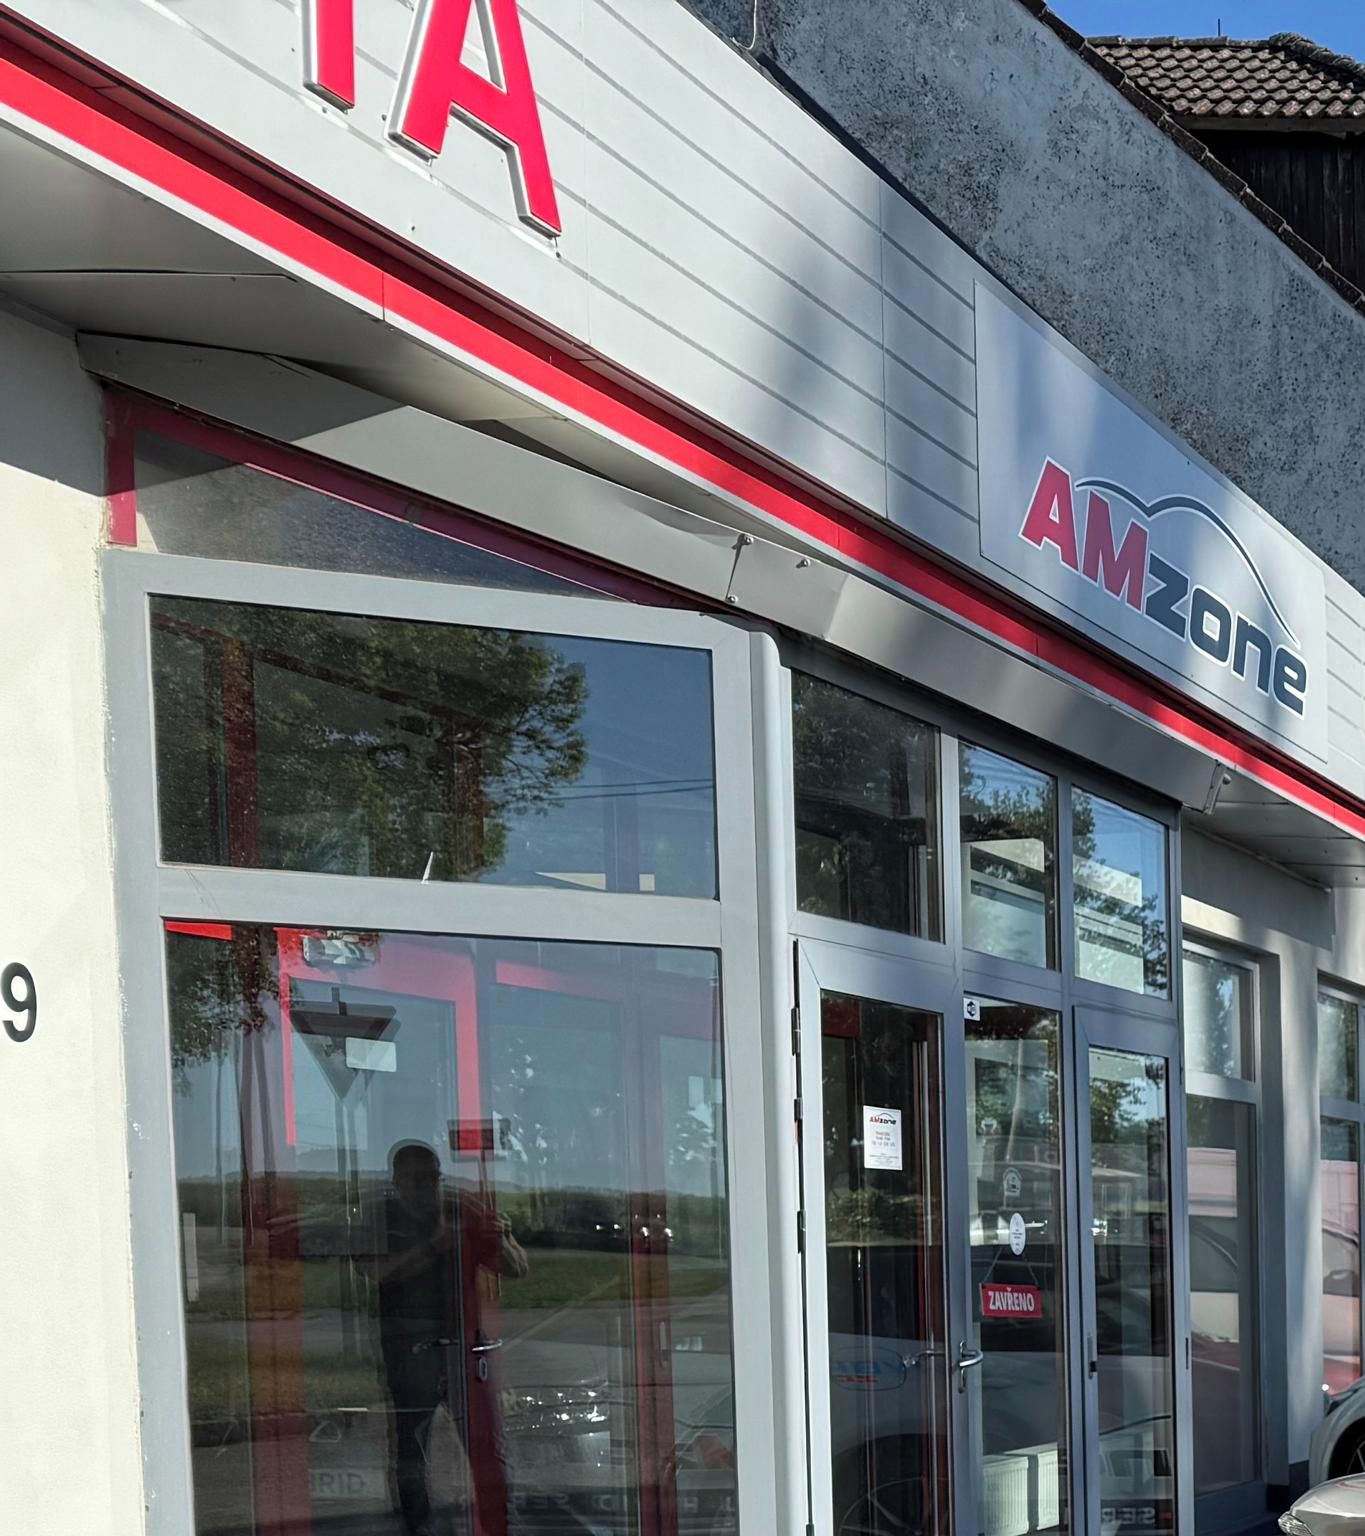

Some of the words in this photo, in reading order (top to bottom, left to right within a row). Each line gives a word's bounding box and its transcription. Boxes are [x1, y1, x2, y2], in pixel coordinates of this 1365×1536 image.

[1018, 456, 1307, 720] AMzone
[0, 961, 38, 1043] 9
[988, 1287, 1035, 1312] ZAVŘENO
